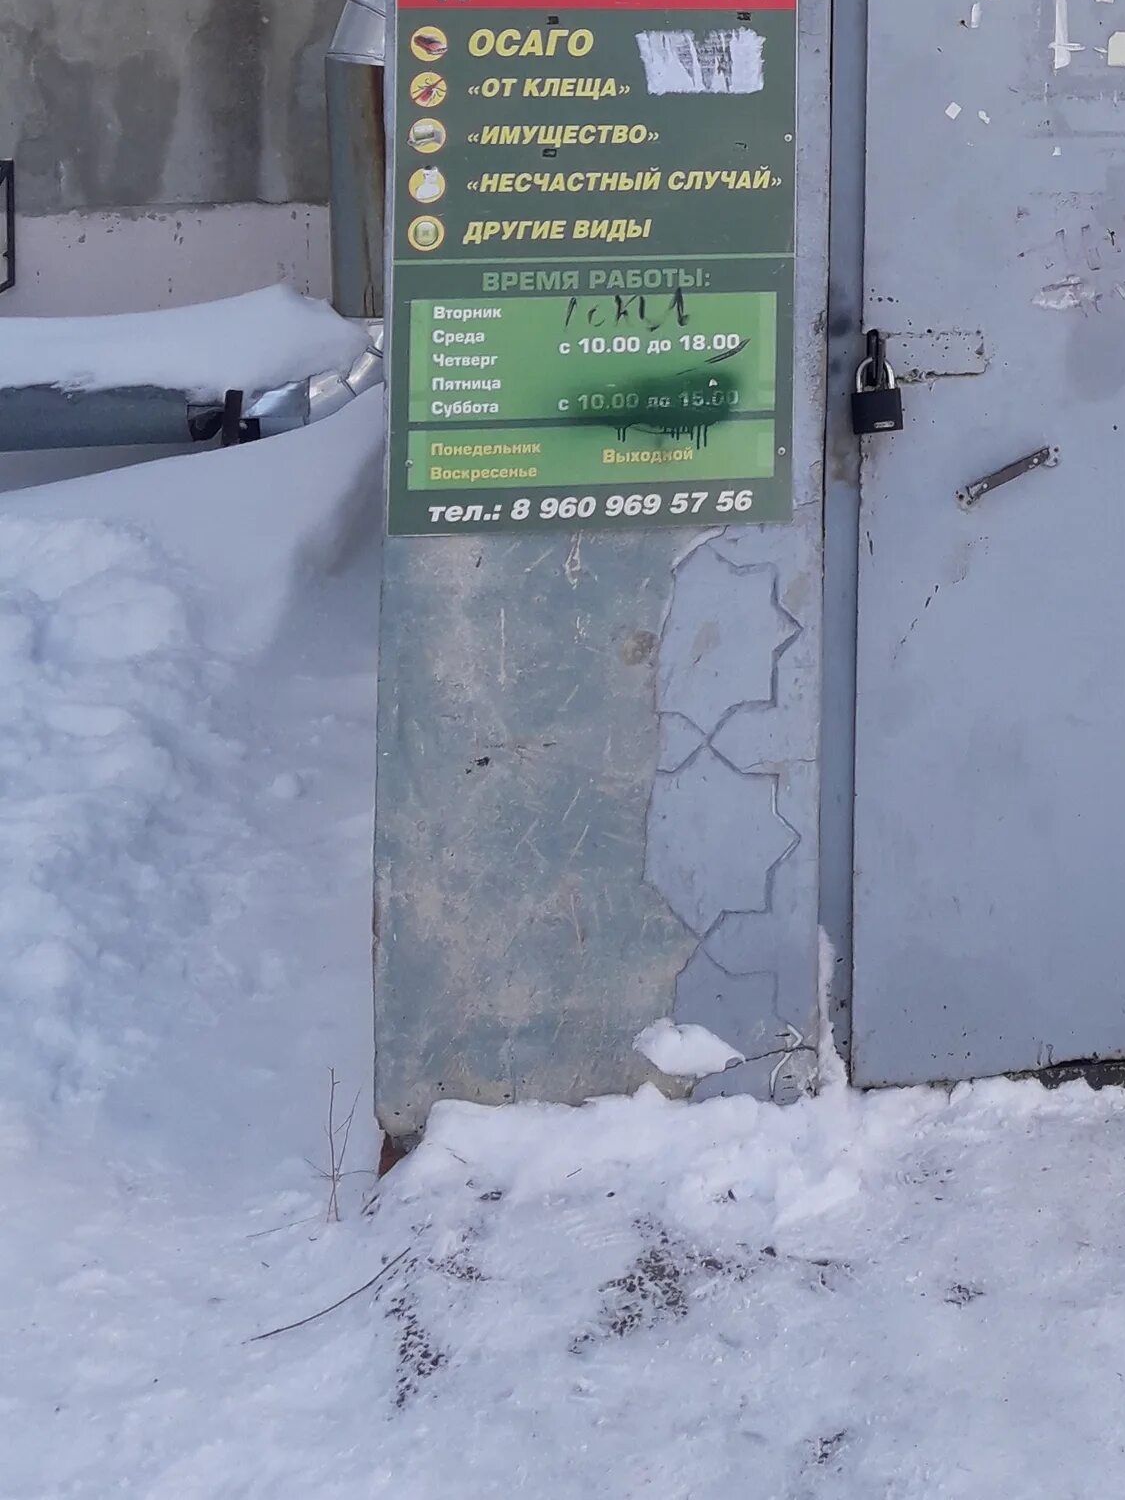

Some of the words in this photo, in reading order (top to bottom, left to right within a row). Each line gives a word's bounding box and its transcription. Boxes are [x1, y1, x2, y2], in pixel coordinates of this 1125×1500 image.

[468, 29, 594, 57] ОСАГО
[468, 78, 517, 97] «ОТ
[523, 77, 631, 100] КЛЕЩА»
[467, 124, 660, 149] «ИМУЩЕСТВО»
[466, 167, 661, 193] «НЕСЧАСТНЫЙ
[668, 165, 783, 191] СЛУЧАЙ»
[462, 220, 566, 245] ДРУГИЕ
[572, 219, 652, 243] ВИДЫ
[482, 270, 580, 292] ВРЕМЯ
[589, 267, 712, 289] РАБОТЫ:
[433, 305, 502, 322] Вторник
[432, 329, 485, 346] Среда
[558, 342, 571, 355] с
[577, 336, 640, 353] 10.00
[646, 339, 671, 354] до
[679, 333, 740, 351] 18.00
[432, 353, 498, 369] Четверг
[431, 377, 502, 393] Пятница
[431, 401, 499, 418] Суббота
[557, 399, 569, 411] с
[577, 393, 639, 410] 10.00
[431, 442, 541, 458] Понедельник
[603, 446, 694, 464] Выходной
[430, 466, 538, 483] Воскресенье
[428, 503, 501, 522] тел.:
[510, 499, 530, 520] 8
[539, 496, 596, 518] 960
[605, 494, 662, 516] 969
[669, 492, 708, 514] 57
[715, 490, 753, 512] 56
